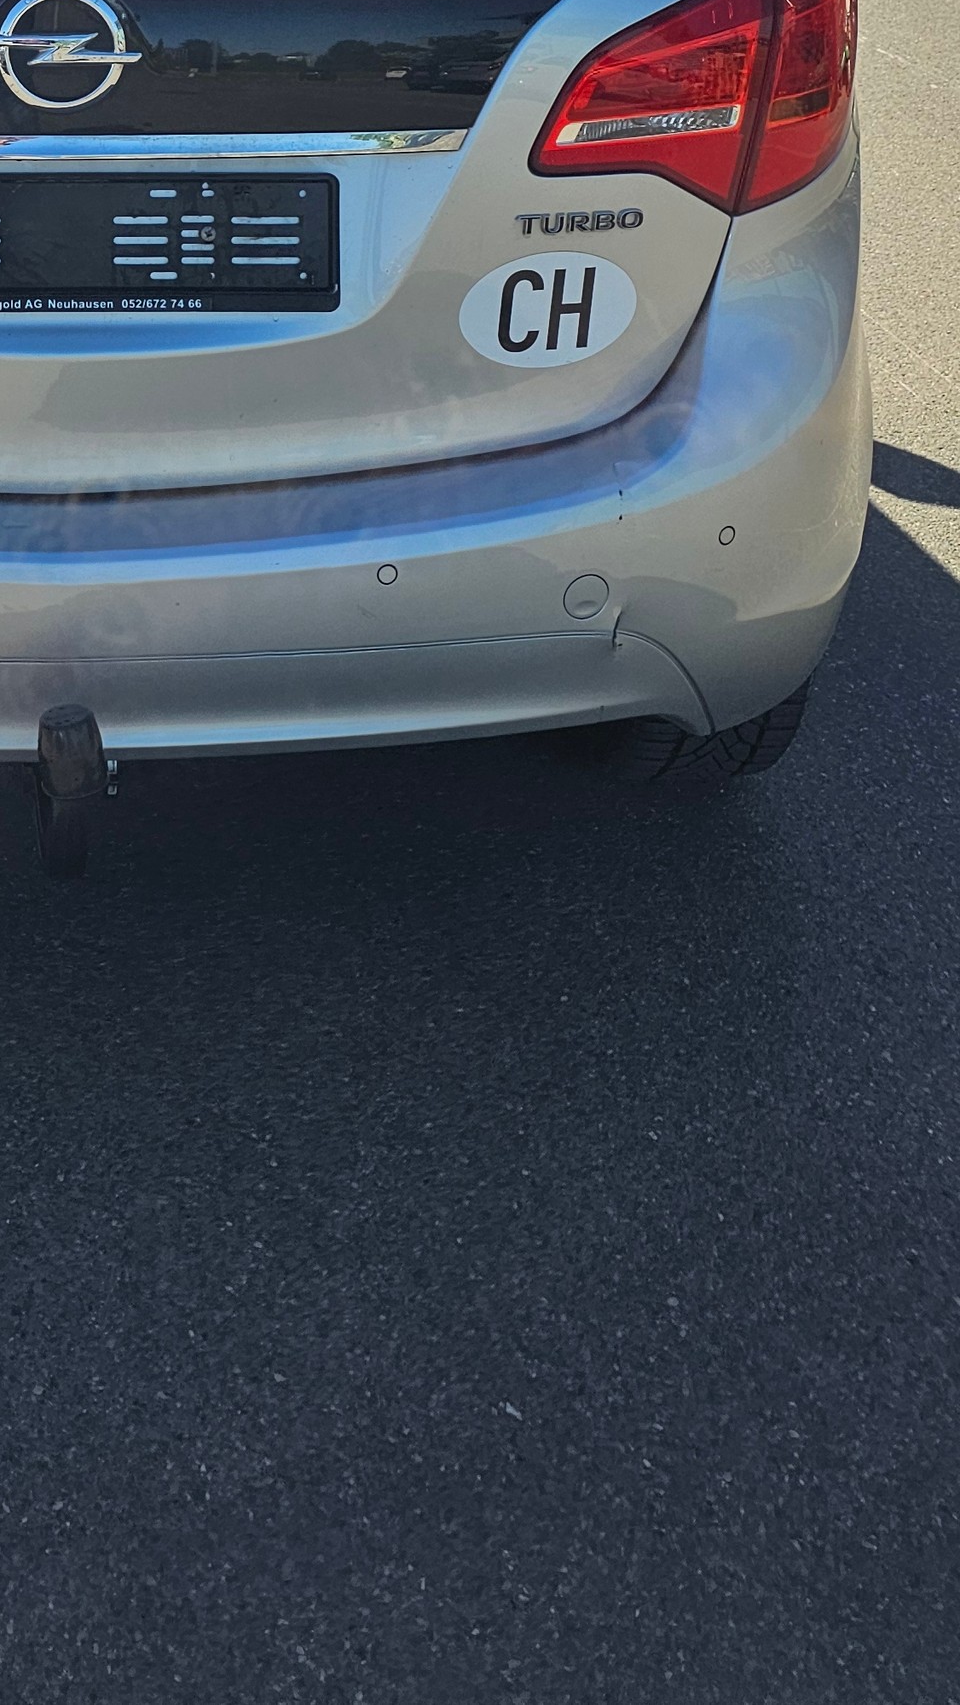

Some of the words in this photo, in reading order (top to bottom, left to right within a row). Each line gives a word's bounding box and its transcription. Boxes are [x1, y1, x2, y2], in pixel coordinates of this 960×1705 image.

[515, 207, 644, 236] TURBO
[25, 299, 43, 309] AG
[48, 299, 114, 309] Neuhausen
[121, 298, 167, 309] 052/672
[171, 298, 184, 309] 74
[188, 298, 202, 309] 66
[497, 266, 597, 353] CH
